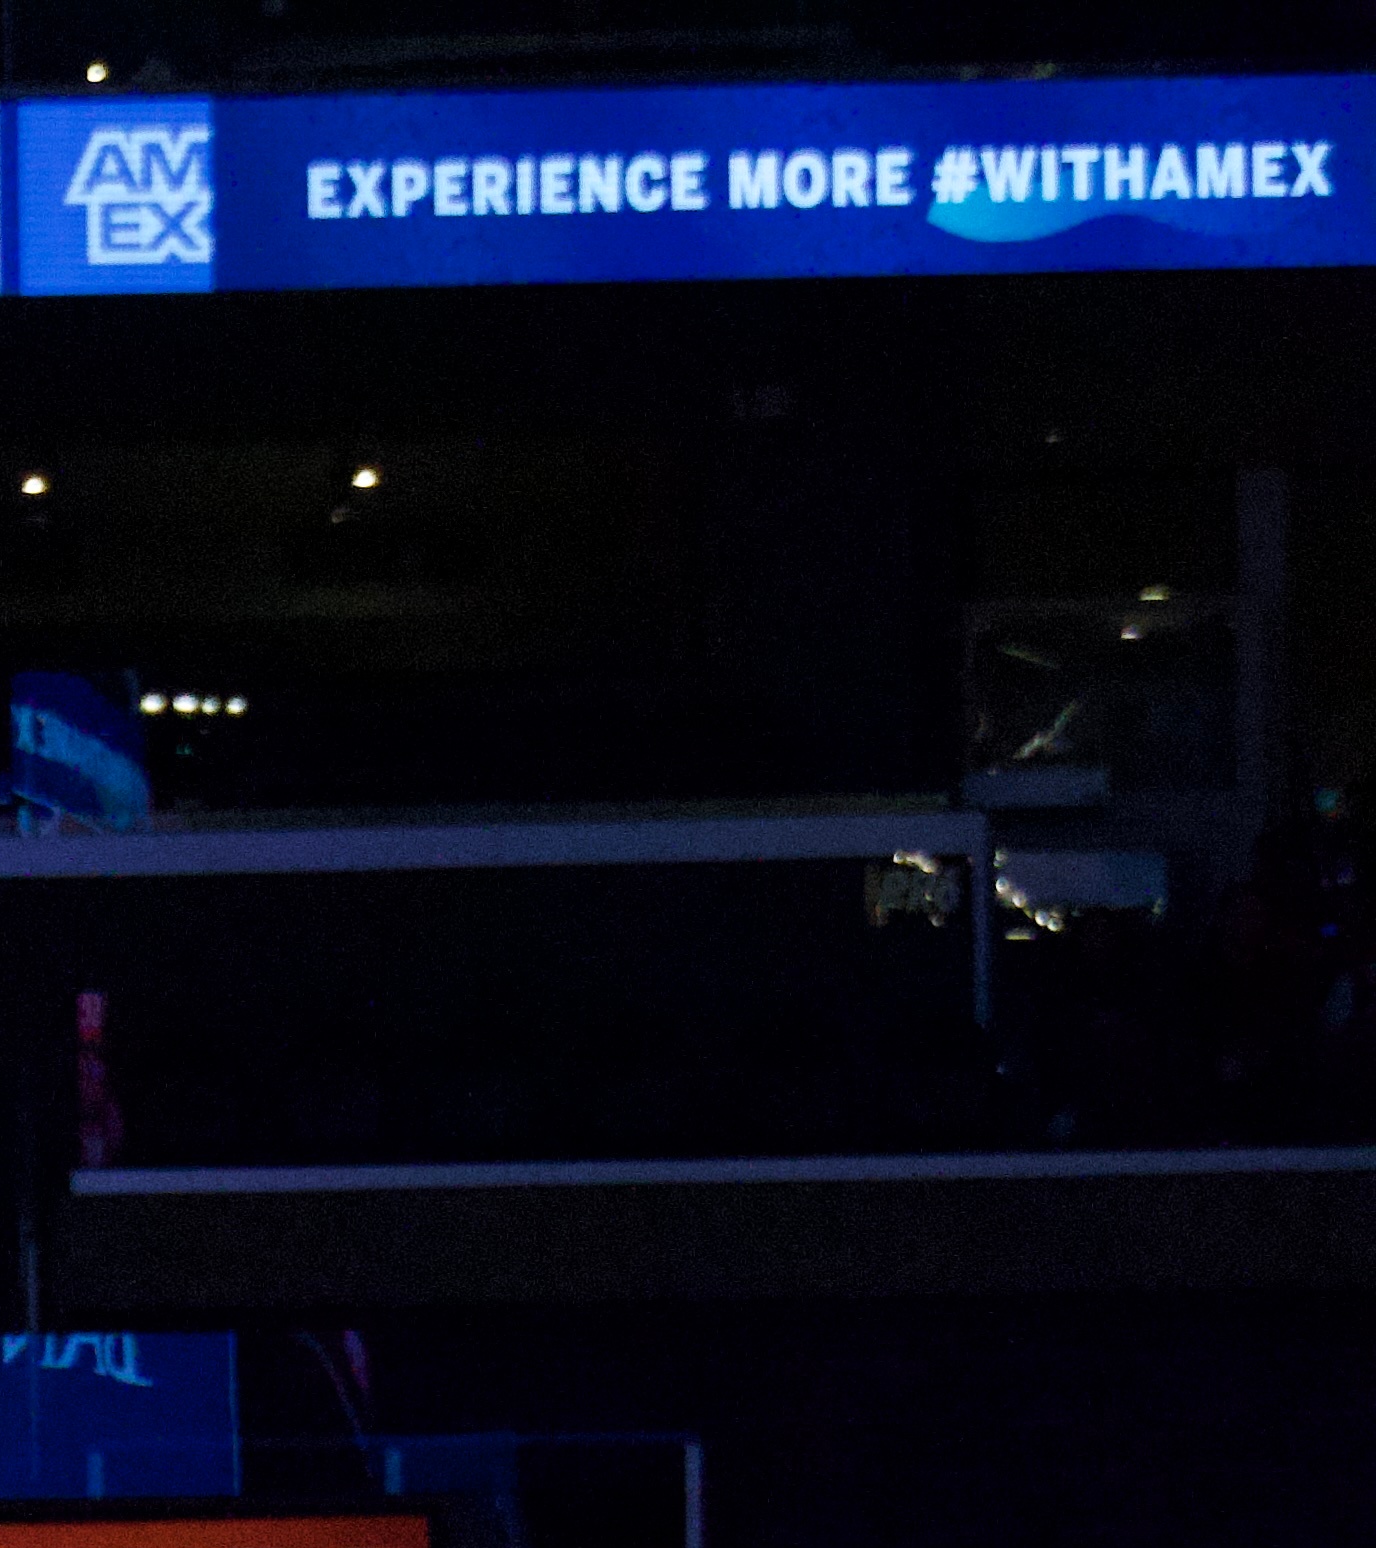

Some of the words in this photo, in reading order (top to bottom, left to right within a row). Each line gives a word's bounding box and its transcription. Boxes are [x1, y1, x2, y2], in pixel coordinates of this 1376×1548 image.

[306, 151, 708, 221] EXPERIENCE
[728, 147, 914, 211] MORE
[932, 140, 1335, 205] #WITHAMEX
